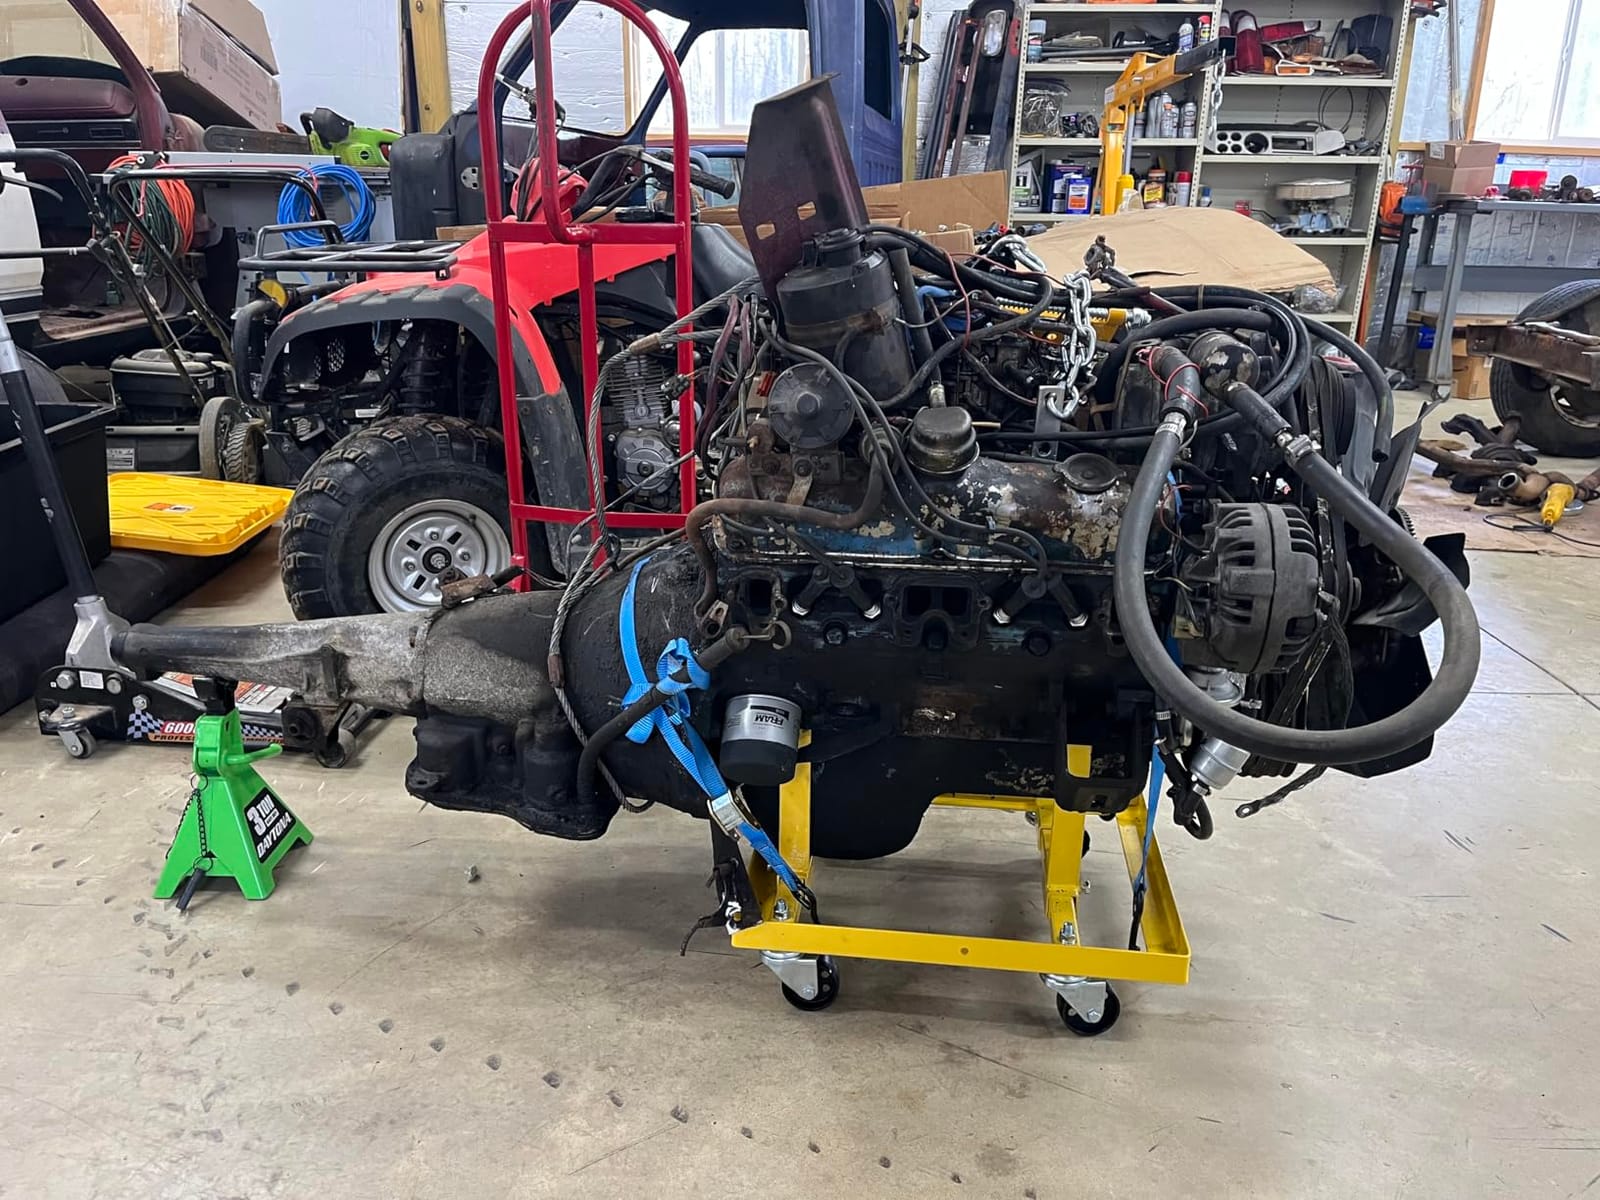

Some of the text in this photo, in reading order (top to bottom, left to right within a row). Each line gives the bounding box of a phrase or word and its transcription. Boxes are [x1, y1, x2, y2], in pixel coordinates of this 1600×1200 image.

[755, 714, 784, 725] FRAM
[256, 794, 275, 818] TON
[246, 806, 267, 836] 3
[257, 812, 292, 858] DAYTONA
